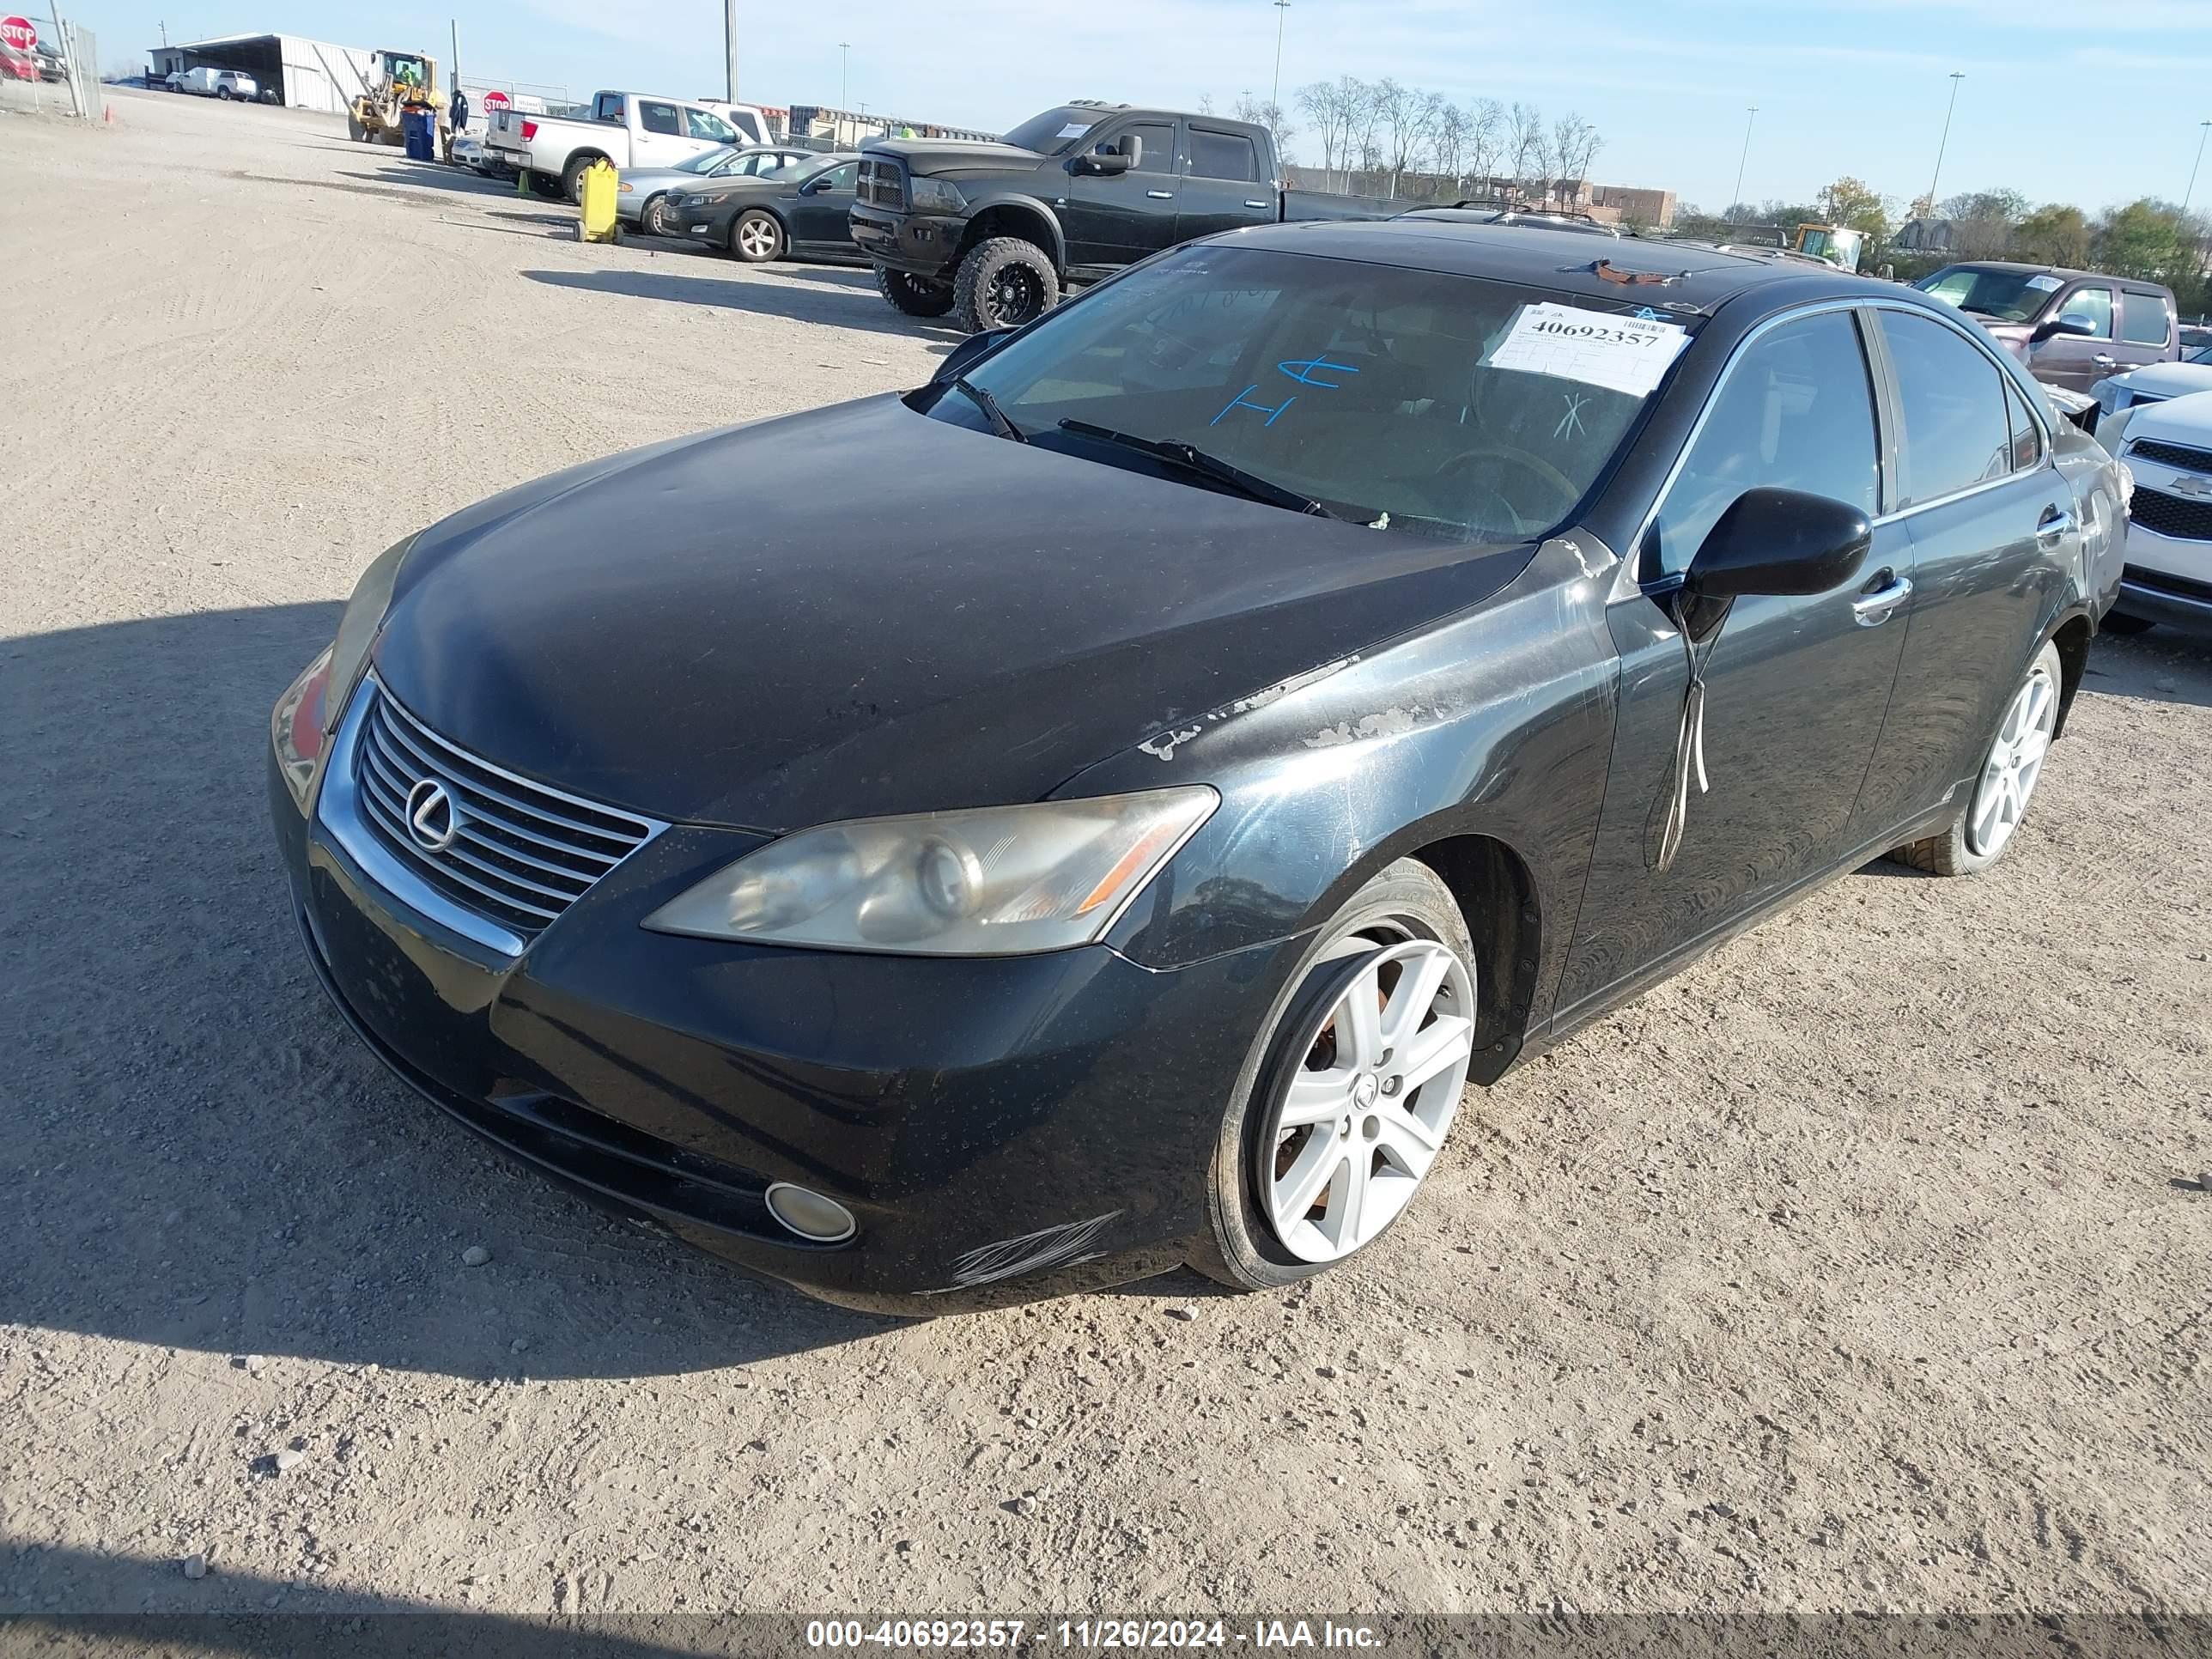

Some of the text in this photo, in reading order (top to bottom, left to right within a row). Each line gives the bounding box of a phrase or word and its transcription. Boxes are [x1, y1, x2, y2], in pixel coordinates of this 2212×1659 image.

[2, 25, 35, 41] STOP
[484, 98, 509, 110] STOP
[1531, 319, 1660, 348] 40692357
